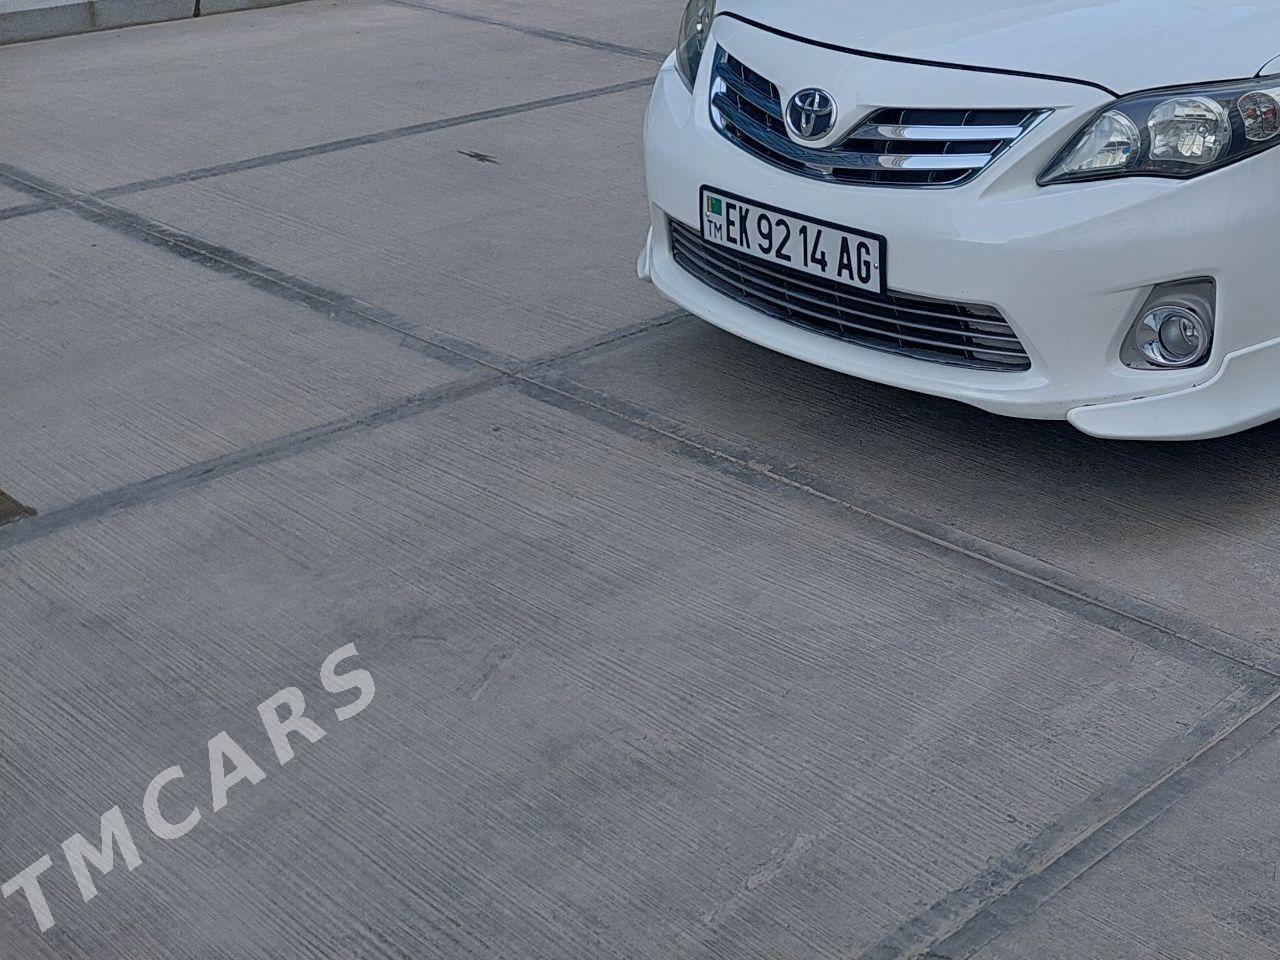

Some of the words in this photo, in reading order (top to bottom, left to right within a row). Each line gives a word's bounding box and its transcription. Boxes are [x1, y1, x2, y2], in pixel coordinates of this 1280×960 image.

[707, 219, 722, 240] TM
[726, 202, 750, 248] EK
[837, 236, 870, 283] AG
